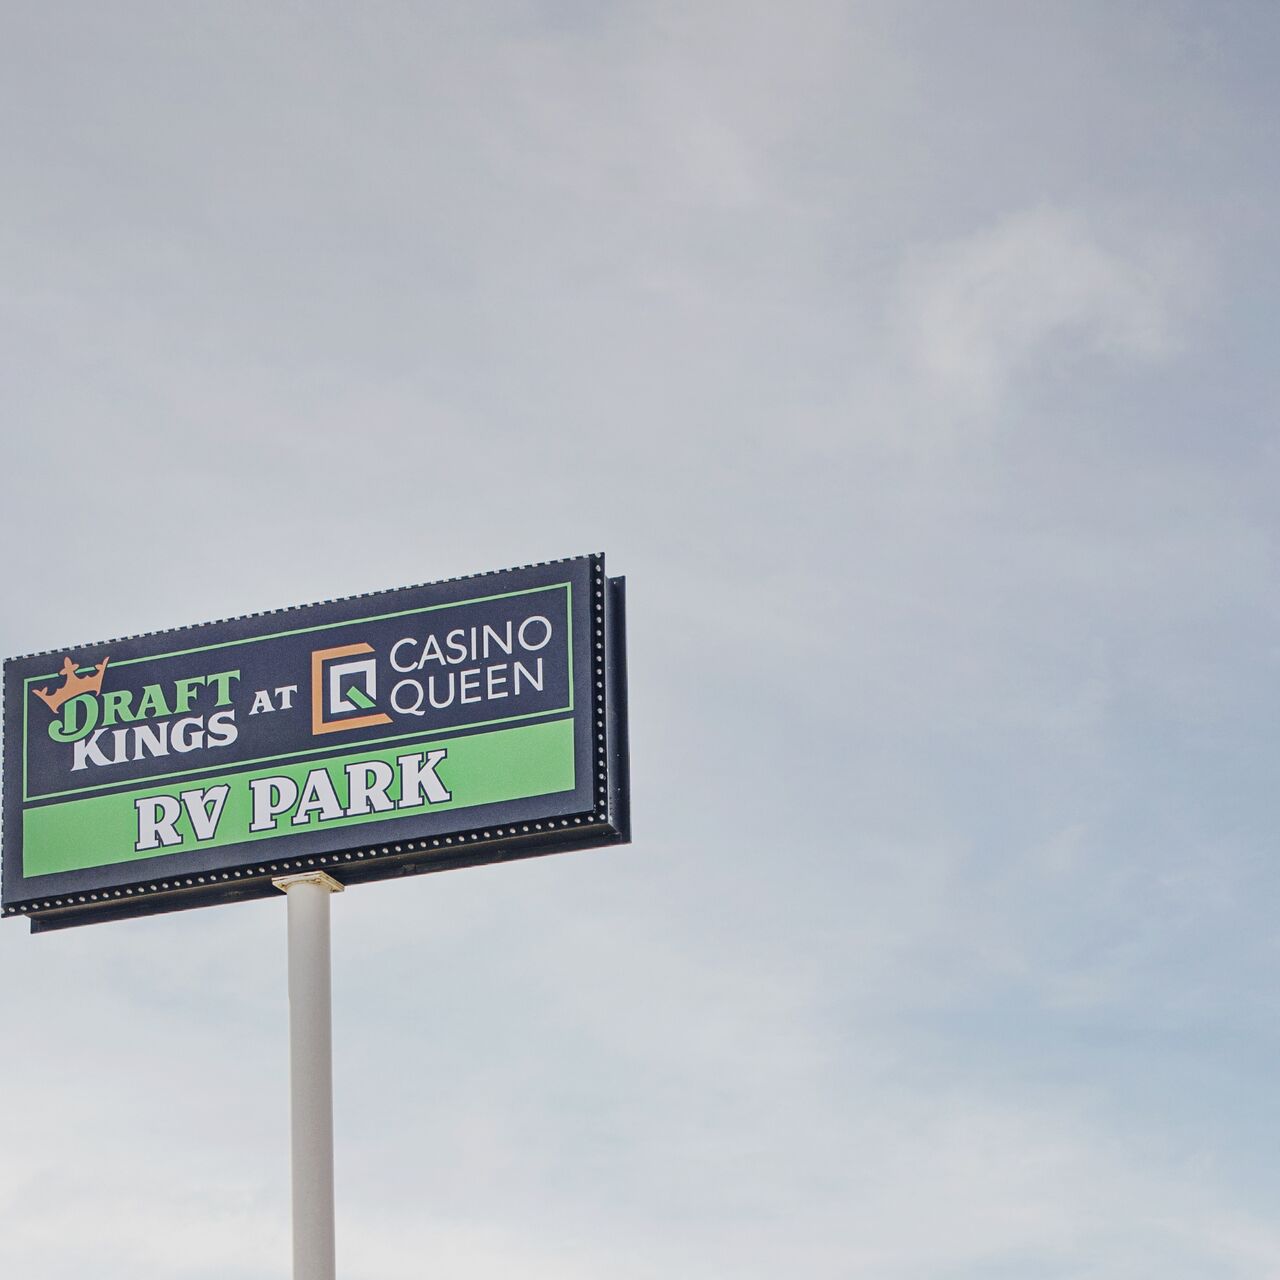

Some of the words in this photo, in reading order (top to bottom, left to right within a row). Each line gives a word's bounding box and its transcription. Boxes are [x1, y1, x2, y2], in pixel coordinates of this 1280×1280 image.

[389, 615, 553, 673] CASINO
[48, 669, 241, 743] DRAFT
[248, 685, 298, 716] AT
[390, 657, 544, 716] QUEEN
[70, 709, 239, 772] KINGS
[135, 783, 231, 851] RV
[249, 749, 452, 833] PARK
